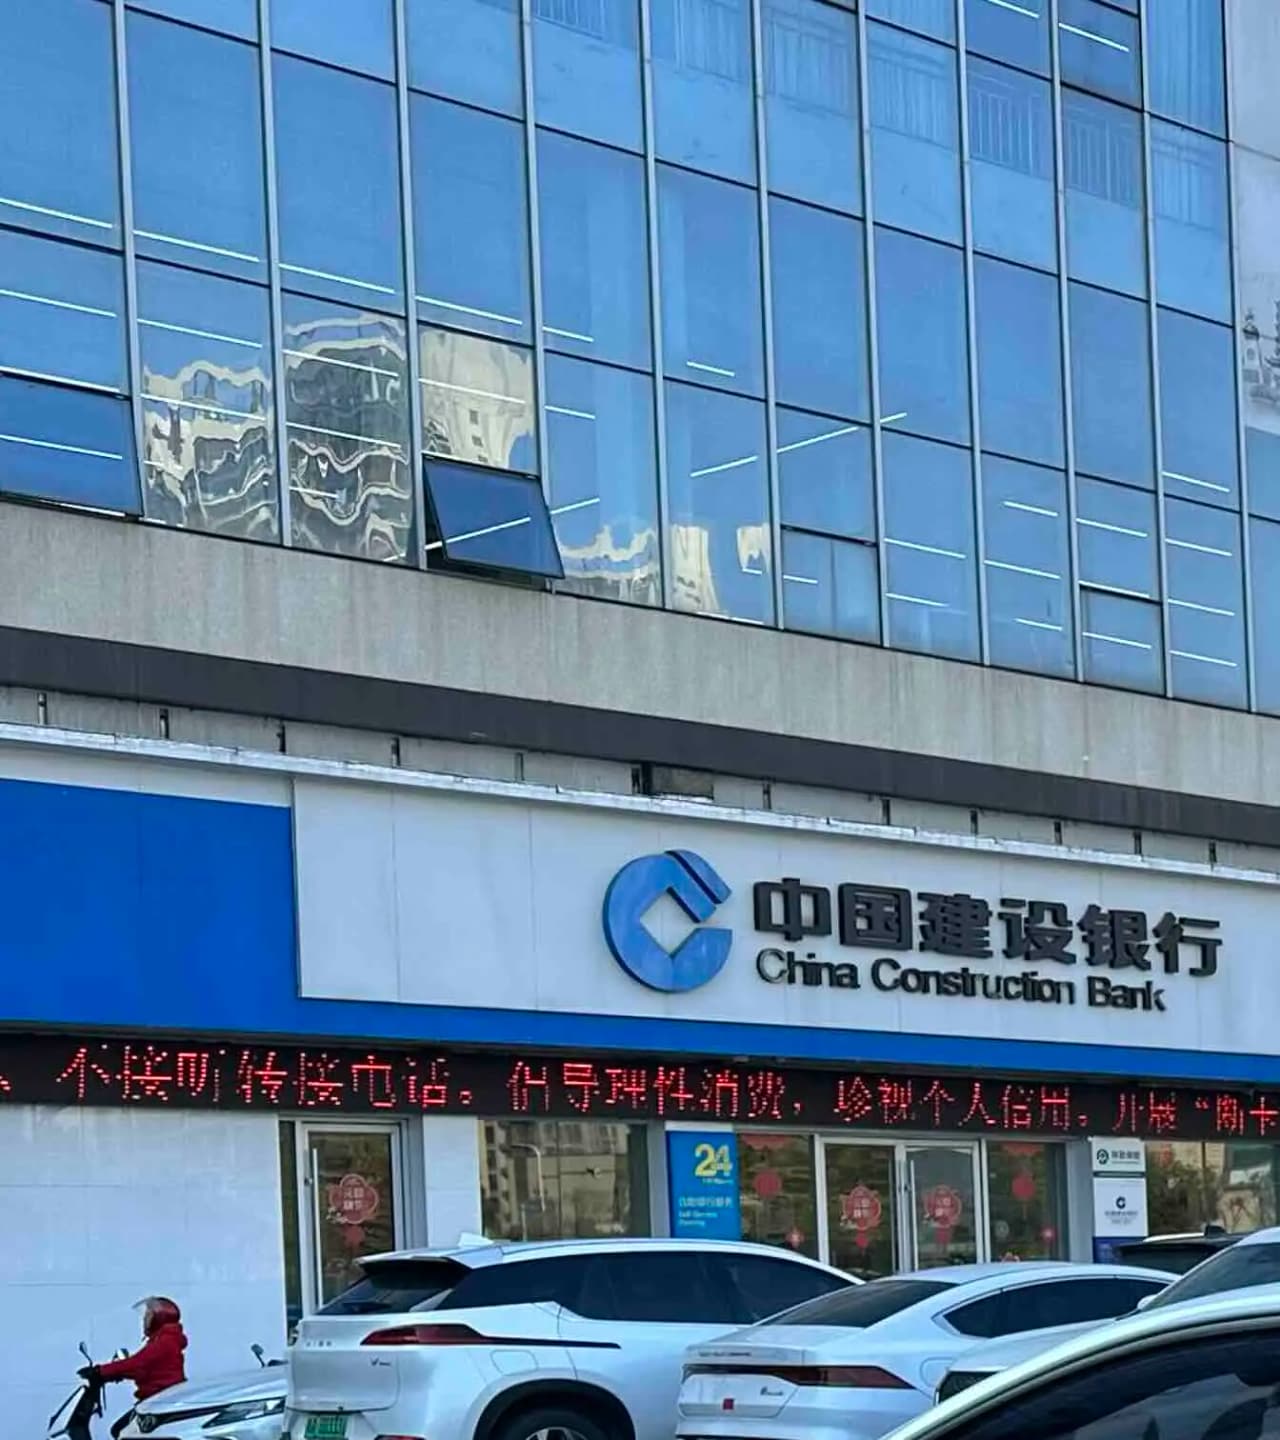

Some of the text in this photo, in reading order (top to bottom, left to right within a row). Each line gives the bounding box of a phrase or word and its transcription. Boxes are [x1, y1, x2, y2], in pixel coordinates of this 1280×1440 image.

[753, 877, 1223, 977] 中国建设银行
[756, 947, 1166, 1012] China Construction Bank
